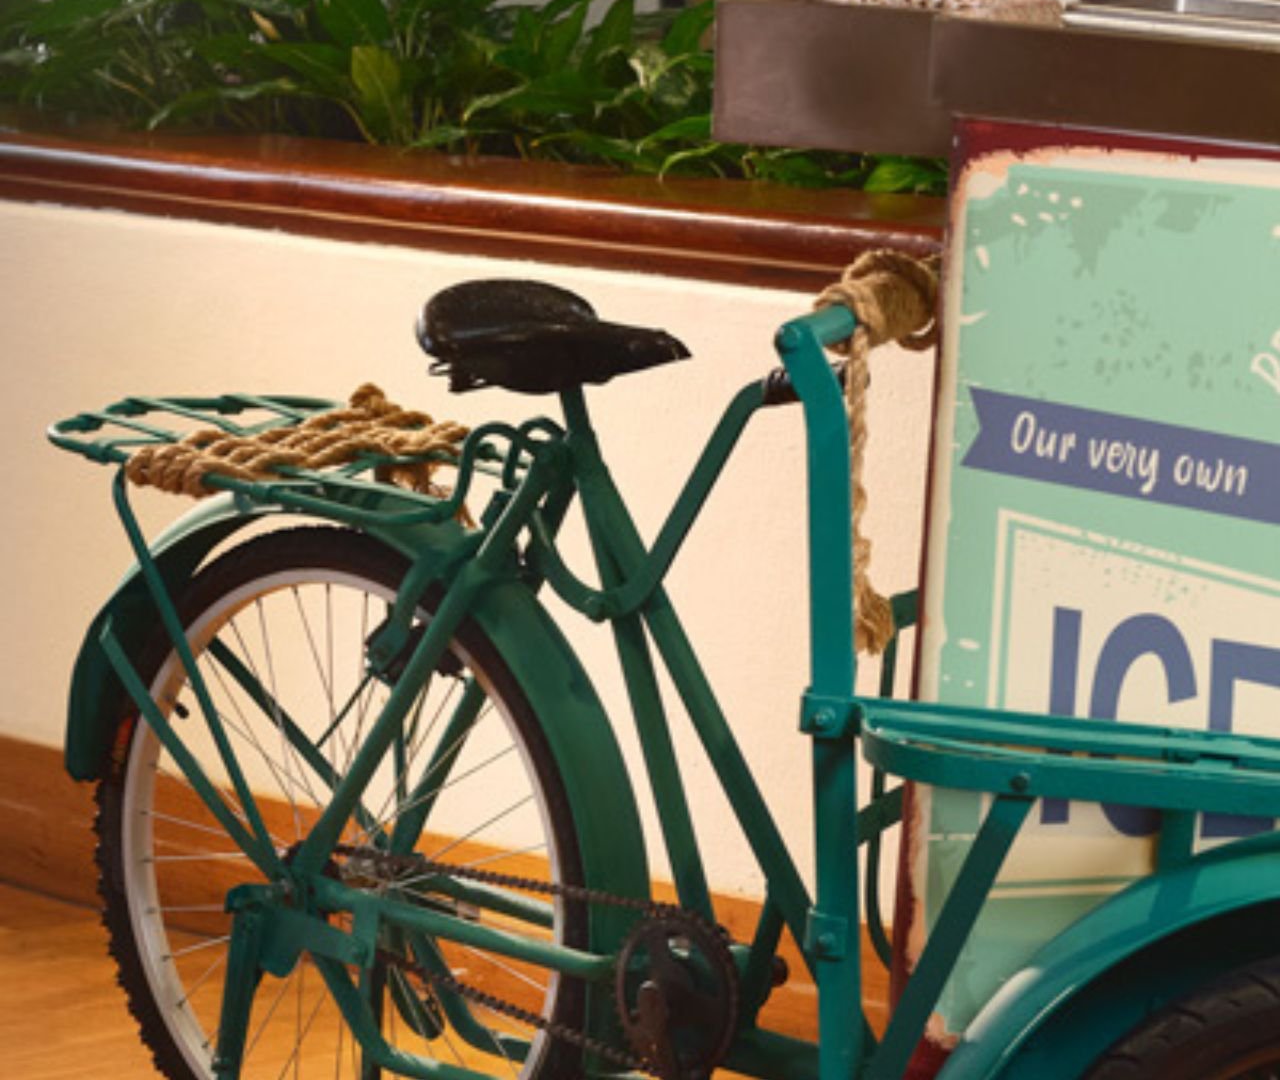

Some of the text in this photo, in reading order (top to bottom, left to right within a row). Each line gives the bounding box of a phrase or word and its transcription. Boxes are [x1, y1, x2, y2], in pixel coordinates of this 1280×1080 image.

[1010, 410, 1249, 497] Our very own
